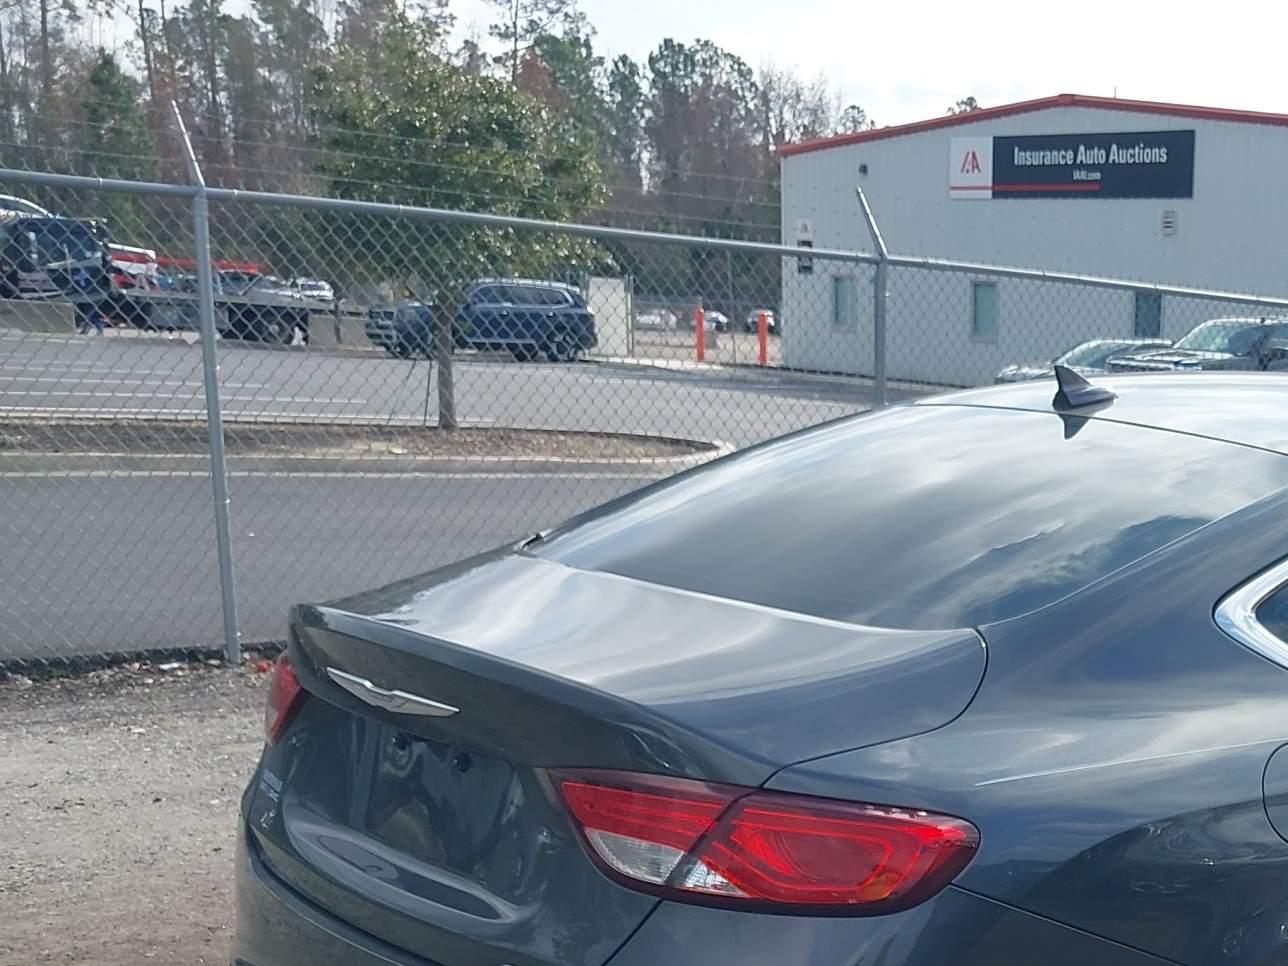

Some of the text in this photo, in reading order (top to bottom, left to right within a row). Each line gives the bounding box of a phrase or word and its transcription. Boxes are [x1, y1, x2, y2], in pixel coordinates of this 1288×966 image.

[1013, 143, 1168, 166] Insurance Auto Auctions
